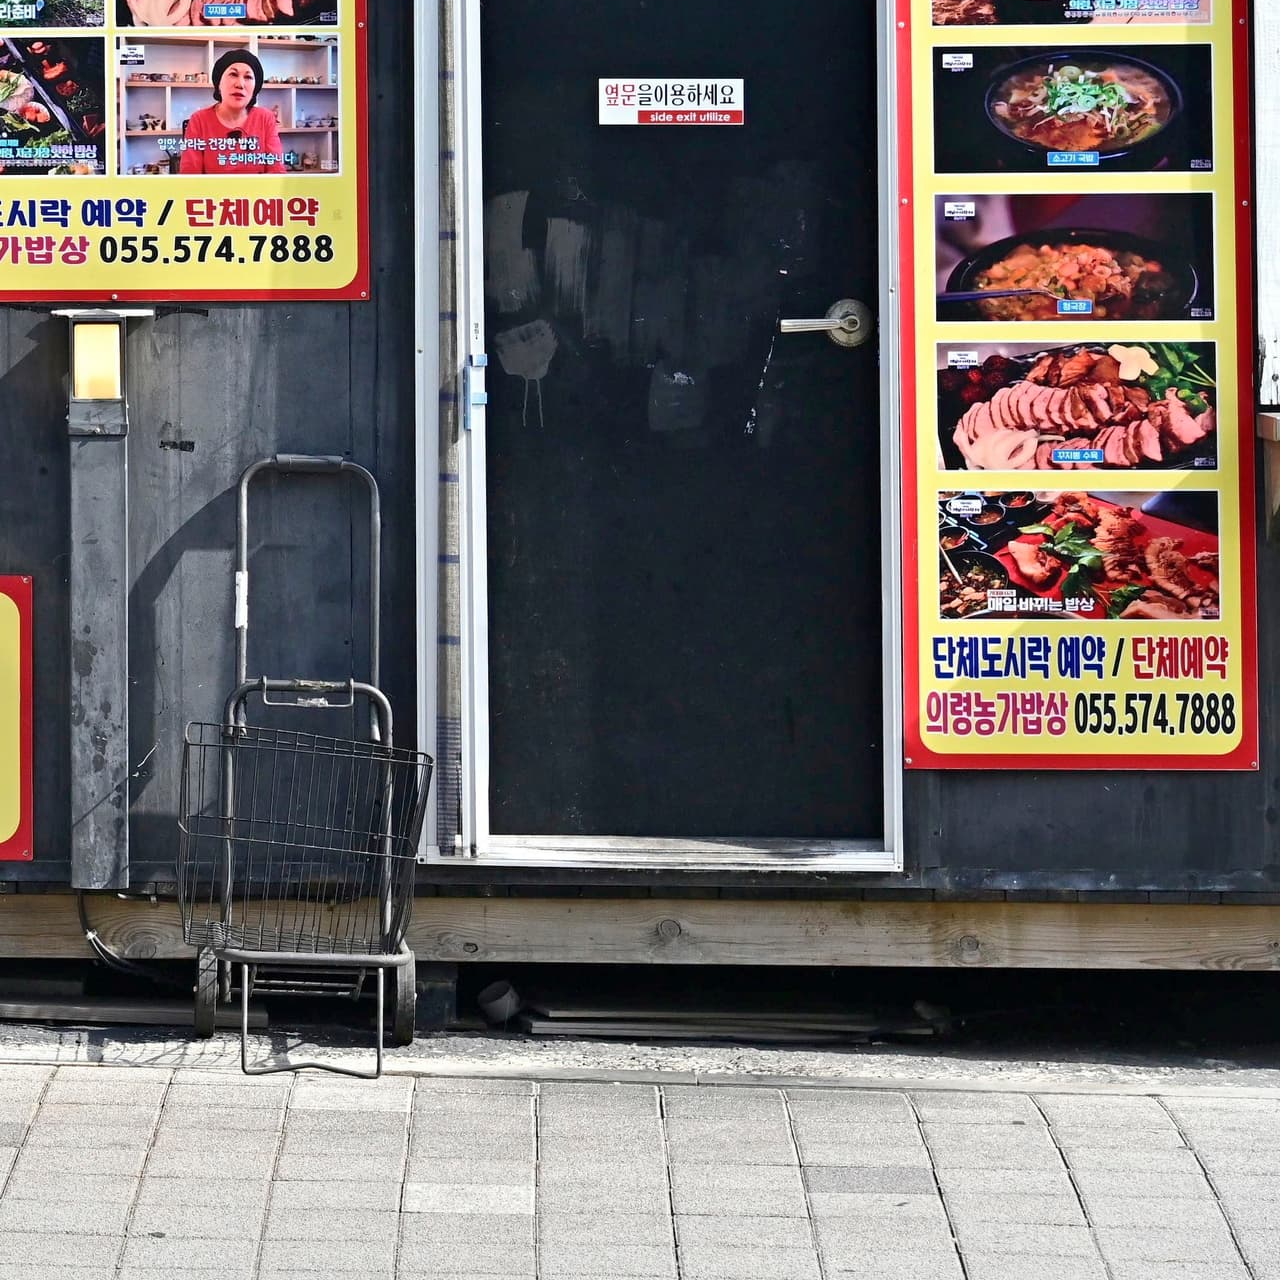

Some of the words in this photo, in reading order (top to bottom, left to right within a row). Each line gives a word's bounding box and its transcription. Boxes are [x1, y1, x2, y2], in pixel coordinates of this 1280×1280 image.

[605, 83, 735, 106] 옆문을이용하세요
[650, 112, 673, 121] side
[676, 112, 697, 121] exit
[700, 112, 731, 121] utilize
[82, 198, 146, 227] 예약
[186, 197, 320, 227] 단체예약
[100, 234, 334, 264] 055.574.7888
[987, 597, 1017, 612] 매일
[1019, 597, 1063, 612] 바뀌는
[1065, 597, 1094, 611] 밥상
[932, 636, 1052, 680] 단체도시락
[1058, 635, 1105, 679] 예약
[1132, 635, 1228, 680] 단체예약
[926, 692, 1068, 736] 의령농가밥상
[1074, 692, 1236, 736] 055.574.7888
